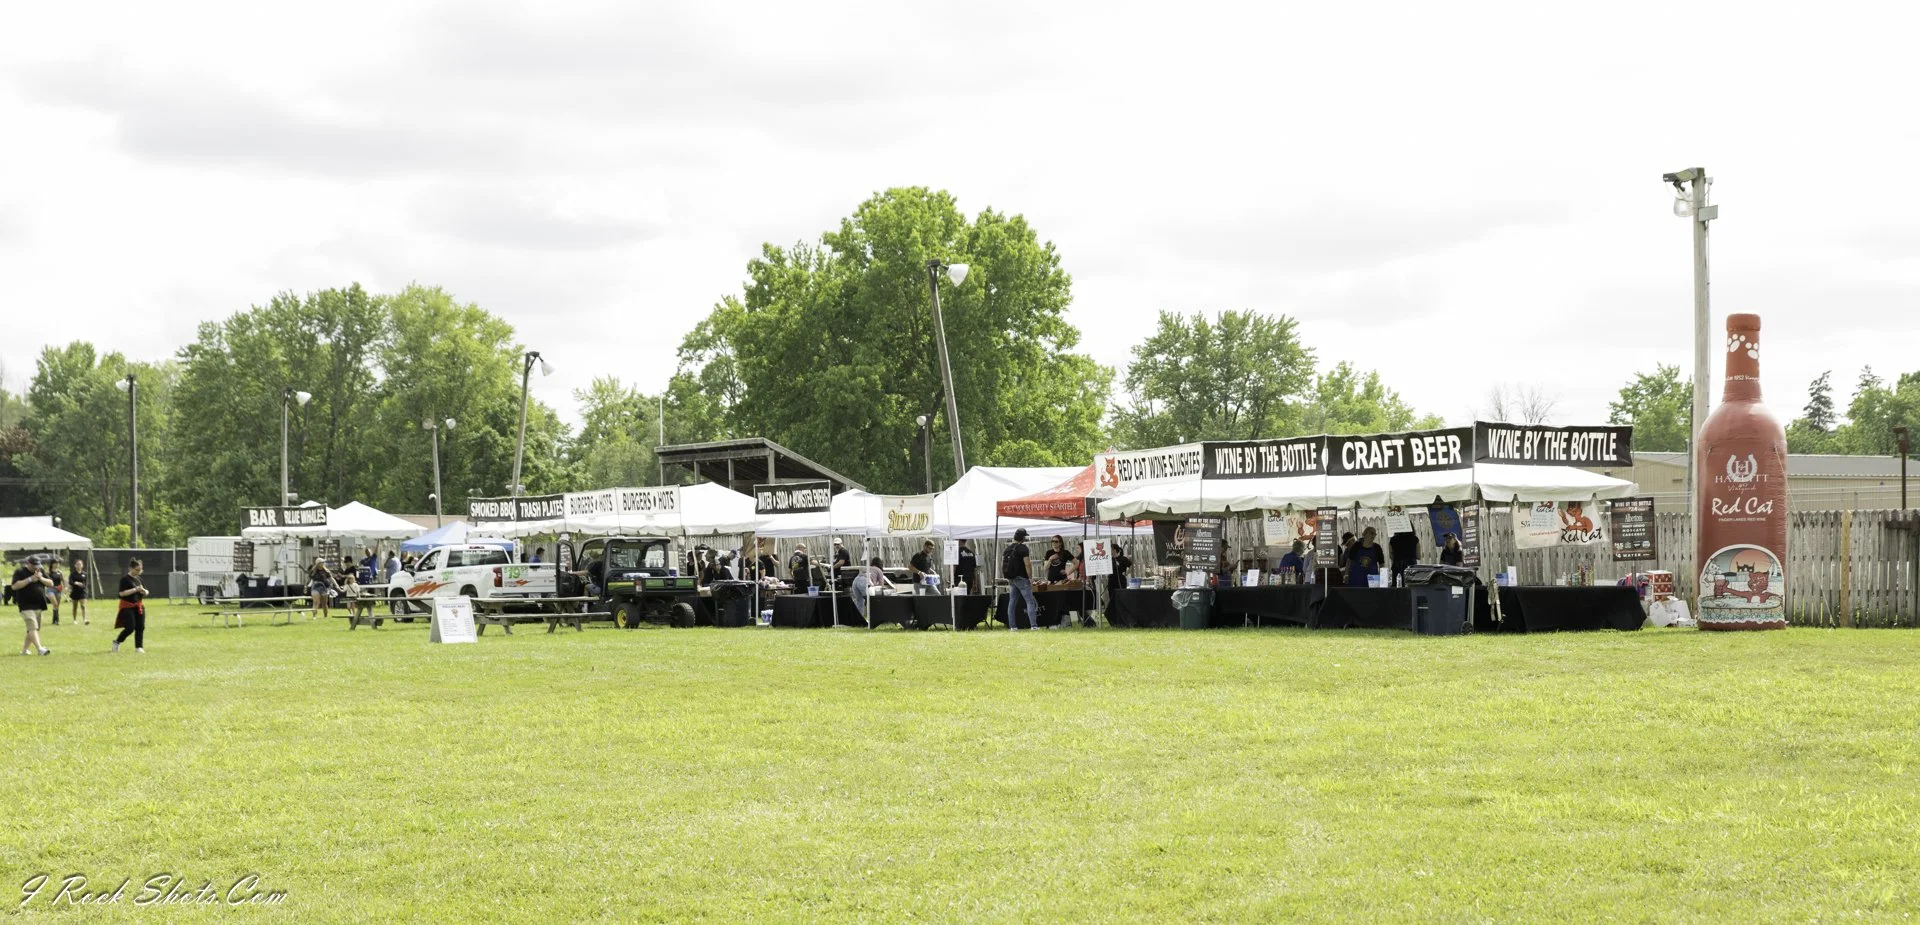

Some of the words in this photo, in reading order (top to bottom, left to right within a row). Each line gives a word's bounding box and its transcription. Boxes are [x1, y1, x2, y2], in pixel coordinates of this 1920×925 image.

[1342, 440, 1405, 470] CRAFT
[1410, 435, 1462, 466] BEER
[1488, 428, 1521, 459] WINE
[1523, 430, 1542, 460] BY
[1544, 431, 1569, 461] THE
[1570, 431, 1617, 461] BOTTLE
[1117, 459, 1132, 481] RED
[1134, 457, 1147, 480] CAT
[1148, 455, 1167, 479] WINE
[1168, 450, 1200, 478] SLUSHIES
[1215, 447, 1242, 474] WINE
[1244, 446, 1257, 474] BY
[1260, 445, 1279, 473] THE
[1280, 442, 1316, 472] BOTTLE
[520, 501, 541, 518] TRASH
[542, 500, 564, 516] PLATES
[570, 496, 594, 515] BURGERS
[598, 494, 613, 512] HOTS
[622, 491, 652, 511] BURGERS
[657, 490, 675, 510] HOTS
[776, 490, 790, 510] SODA
[1015, 504, 1030, 512] YOUR
[1031, 503, 1049, 511] PARTY
[1712, 496, 1742, 516] Red
[1745, 496, 1774, 515] Cat
[249, 509, 278, 526] BAR
[284, 509, 300, 525] BLUE
[300, 508, 326, 524] WHALES
[470, 502, 500, 518] SMOKED
[500, 501, 515, 520] BBQ
[888, 509, 929, 534] BIRDLAND
[1560, 528, 1580, 544] Red
[1580, 526, 1603, 543] Cat
